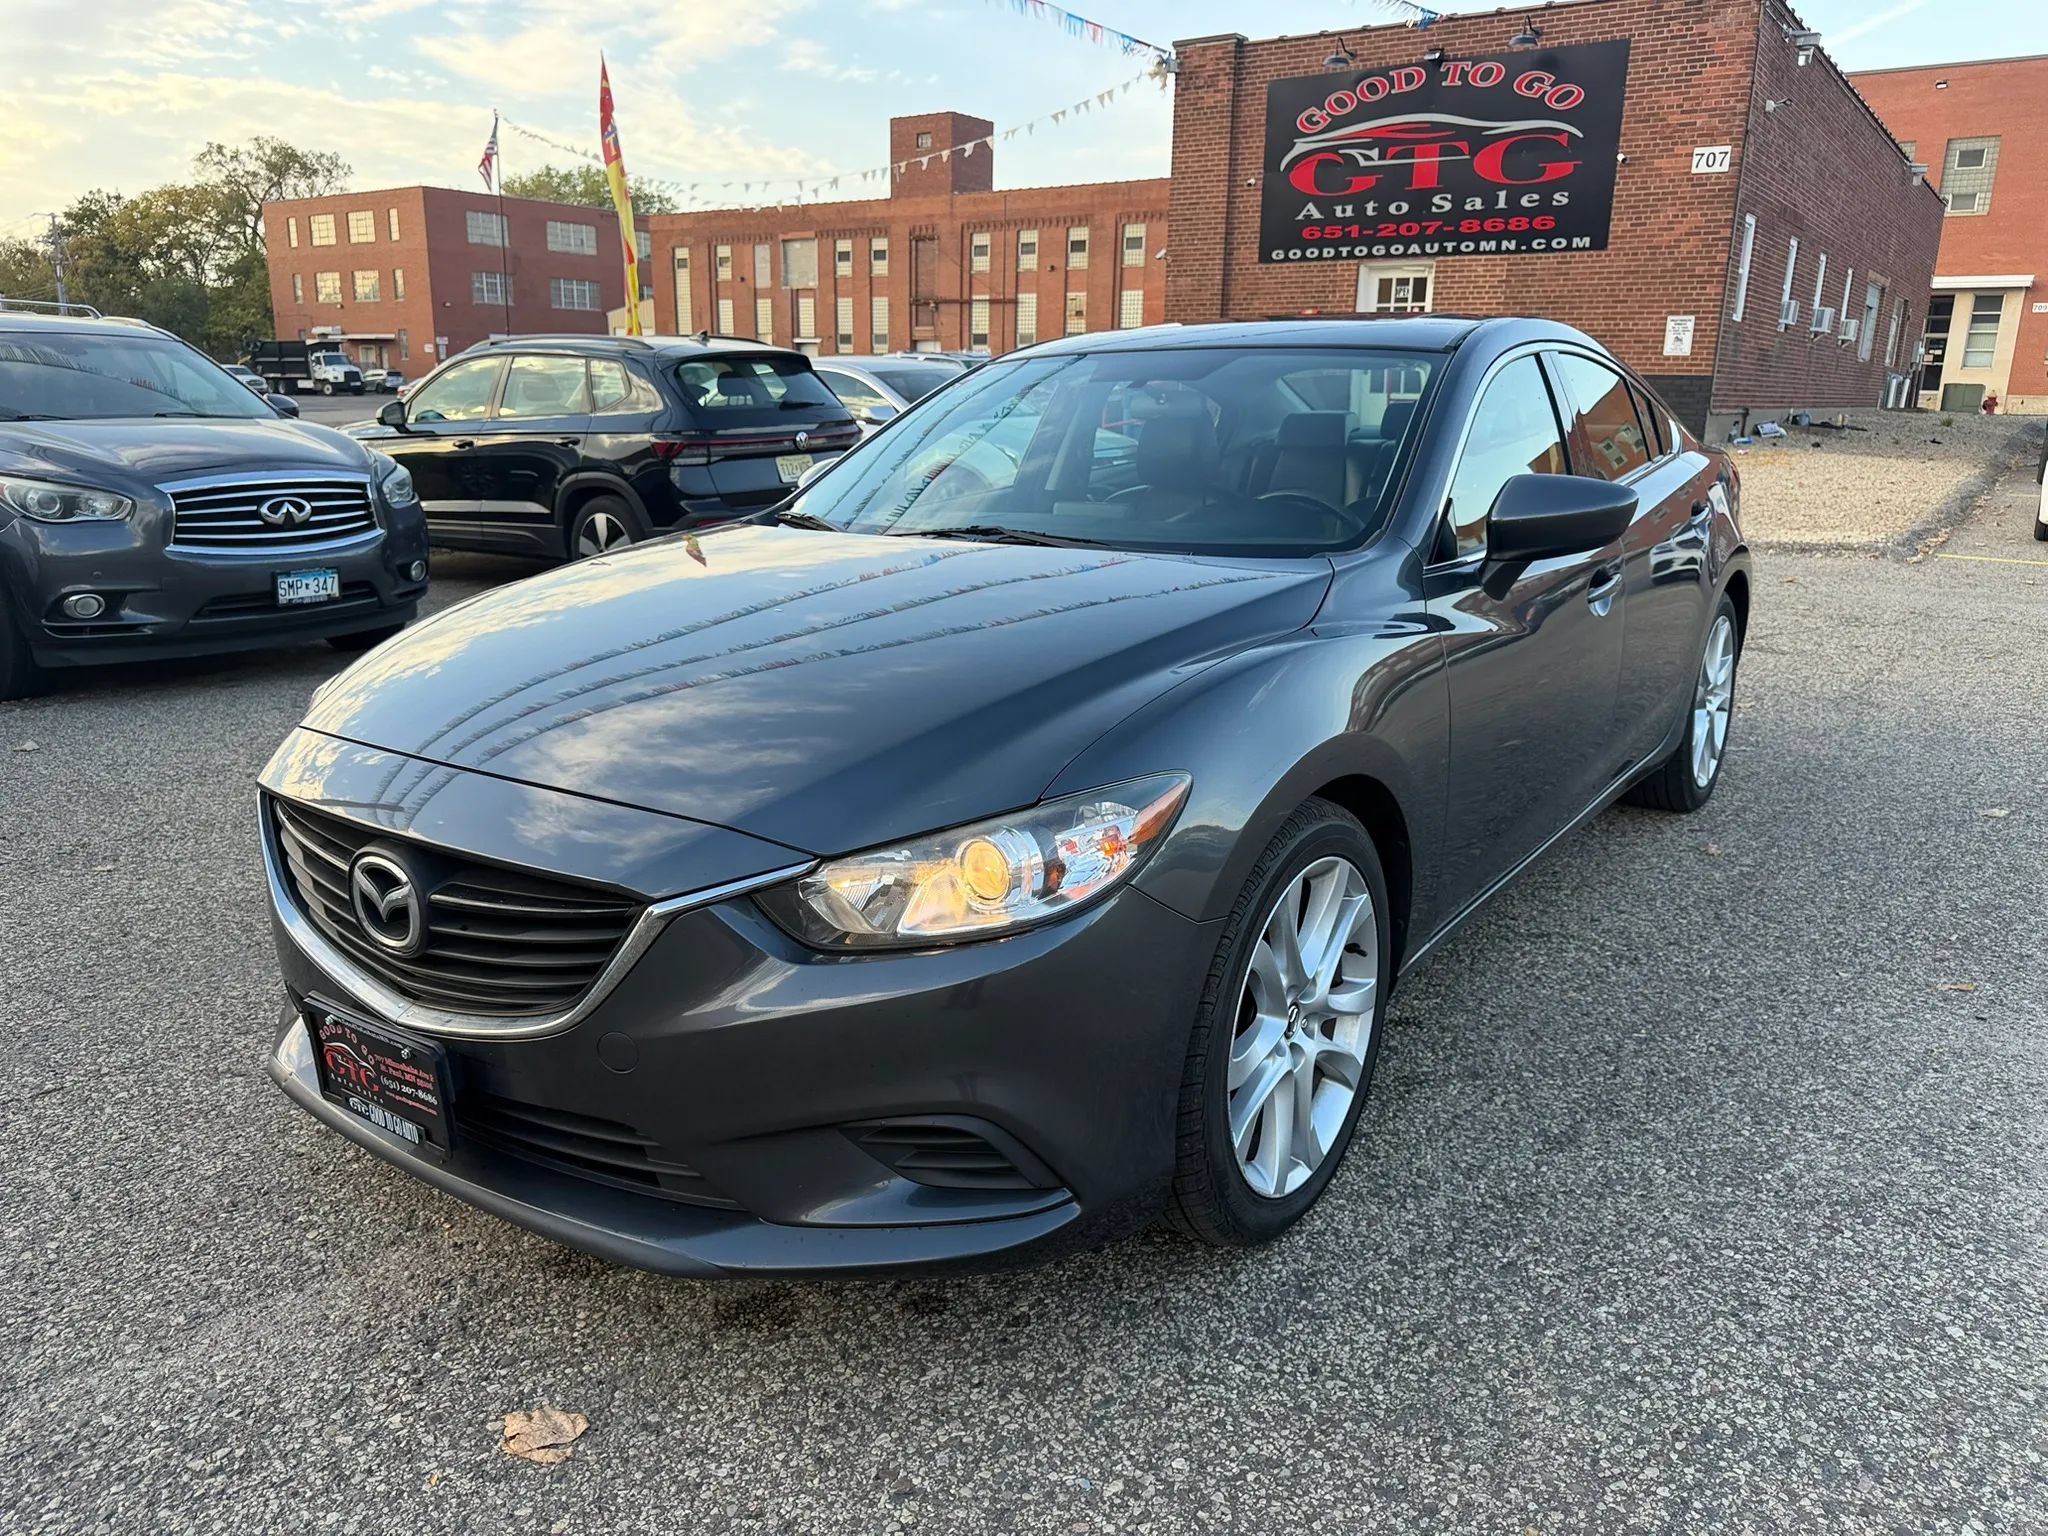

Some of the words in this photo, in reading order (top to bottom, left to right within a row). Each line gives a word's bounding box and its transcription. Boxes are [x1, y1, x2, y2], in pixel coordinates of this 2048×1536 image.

[1296, 65, 1427, 134] GOOD
[1440, 61, 1506, 88] TO
[1513, 70, 1585, 110] GO
[1288, 132, 1583, 197] GTG
[1694, 151, 1729, 169] 707
[1295, 200, 1410, 221] Auto
[1431, 189, 1570, 214] Sales
[1301, 216, 1557, 241] 651-207-8686
[1271, 236, 1592, 261] GOODTOGOAUTOMN.COM
[319, 1024, 343, 1040] GOOD
[345, 1027, 358, 1044] TO
[380, 1075, 400, 1091] (651)
[401, 1084, 438, 1105] 207-8686
[368, 1104, 386, 1127] GOOD
[385, 1112, 393, 1132] TO
[402, 1120, 419, 1145] AUTO
